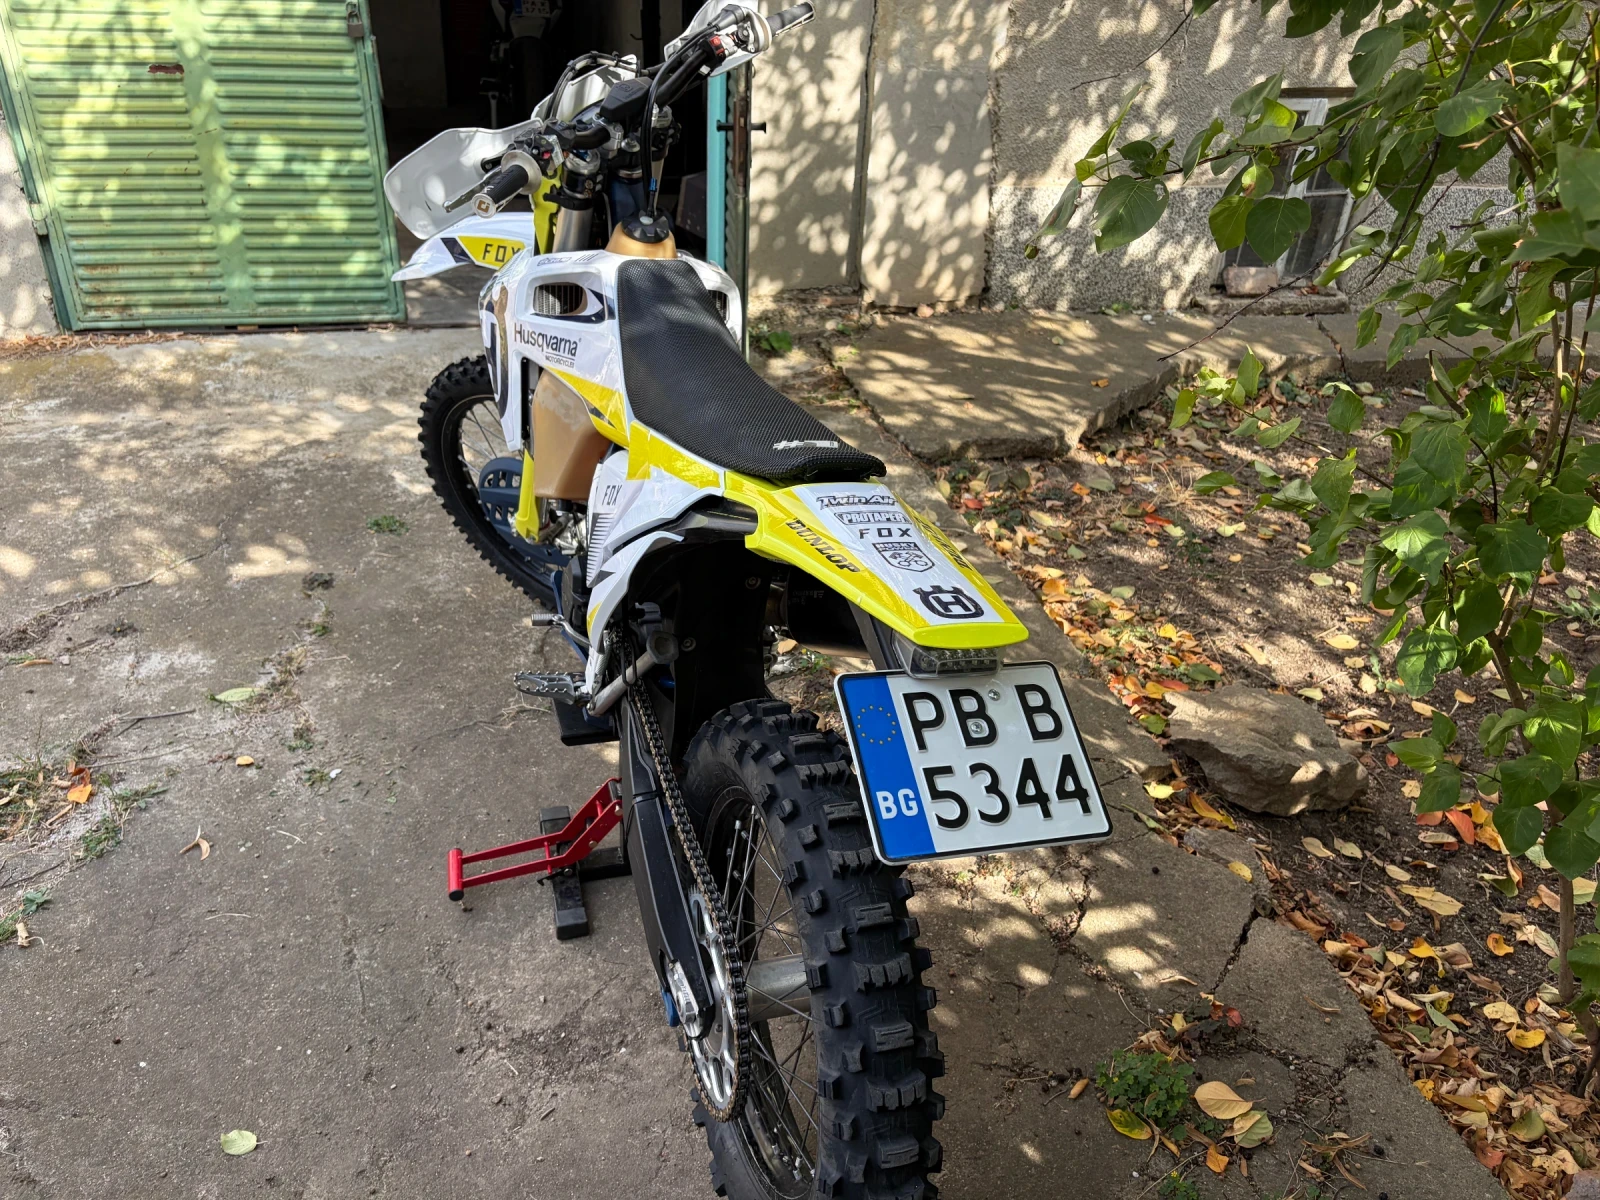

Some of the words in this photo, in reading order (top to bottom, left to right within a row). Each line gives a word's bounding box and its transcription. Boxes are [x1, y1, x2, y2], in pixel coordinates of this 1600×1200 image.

[602, 484, 623, 506] FOX
[842, 512, 907, 524] PROTAPER
[859, 527, 912, 539] FOX
[786, 518, 862, 573] DUNLOP
[900, 688, 998, 752] PB
[1014, 683, 1063, 743] B
[875, 788, 919, 820] BG
[921, 753, 1092, 830] 5344
